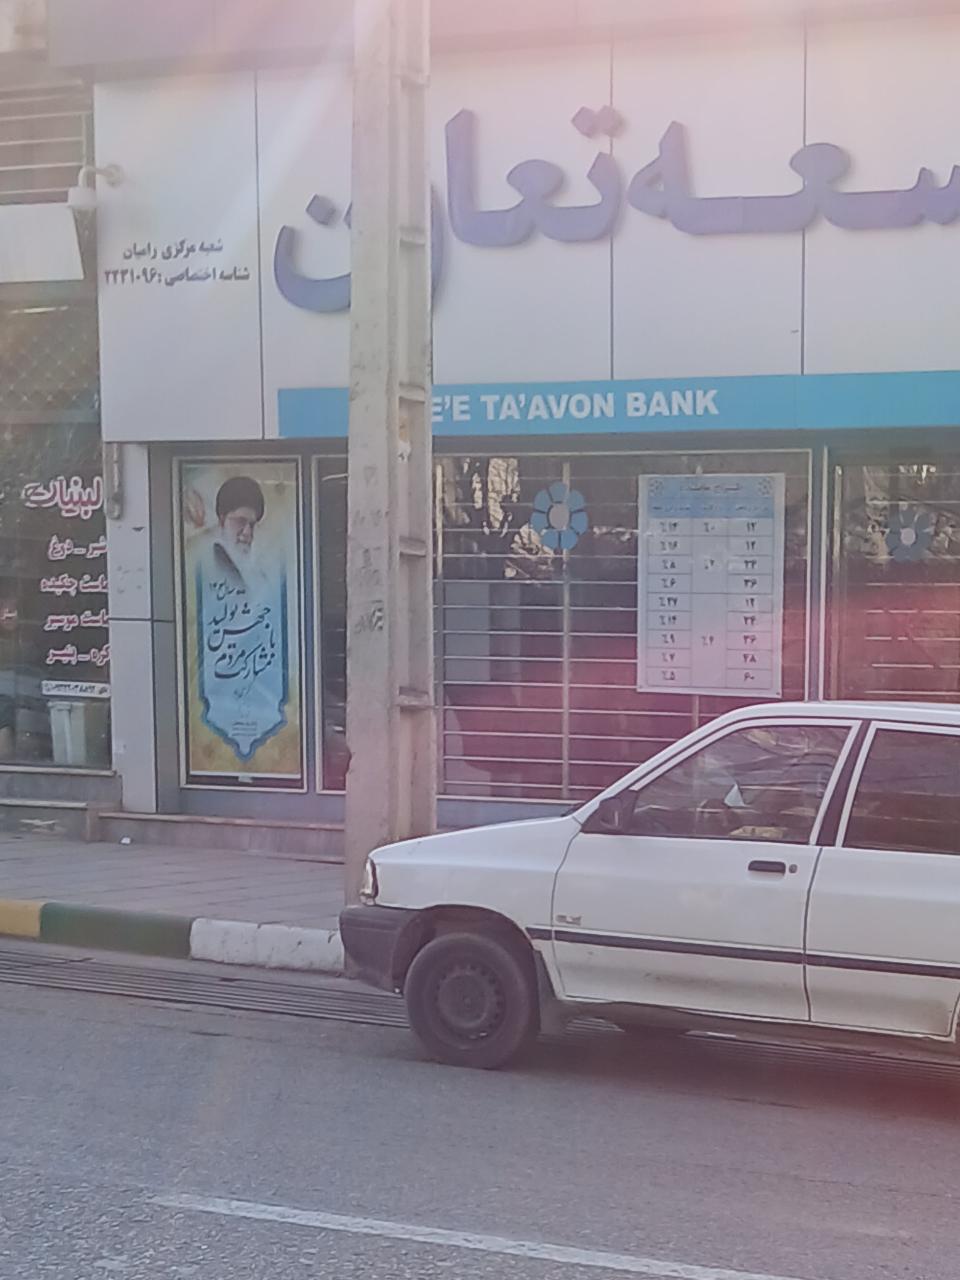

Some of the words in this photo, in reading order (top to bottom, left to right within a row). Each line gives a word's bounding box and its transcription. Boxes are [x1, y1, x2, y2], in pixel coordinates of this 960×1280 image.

[273, 105, 624, 313] تعان
[161, 238, 196, 261] مرکزی
[199, 237, 223, 256] شعبه
[219, 265, 250, 281] شناسه
[480, 392, 614, 421] TA'AVON
[627, 388, 719, 417] BANK
